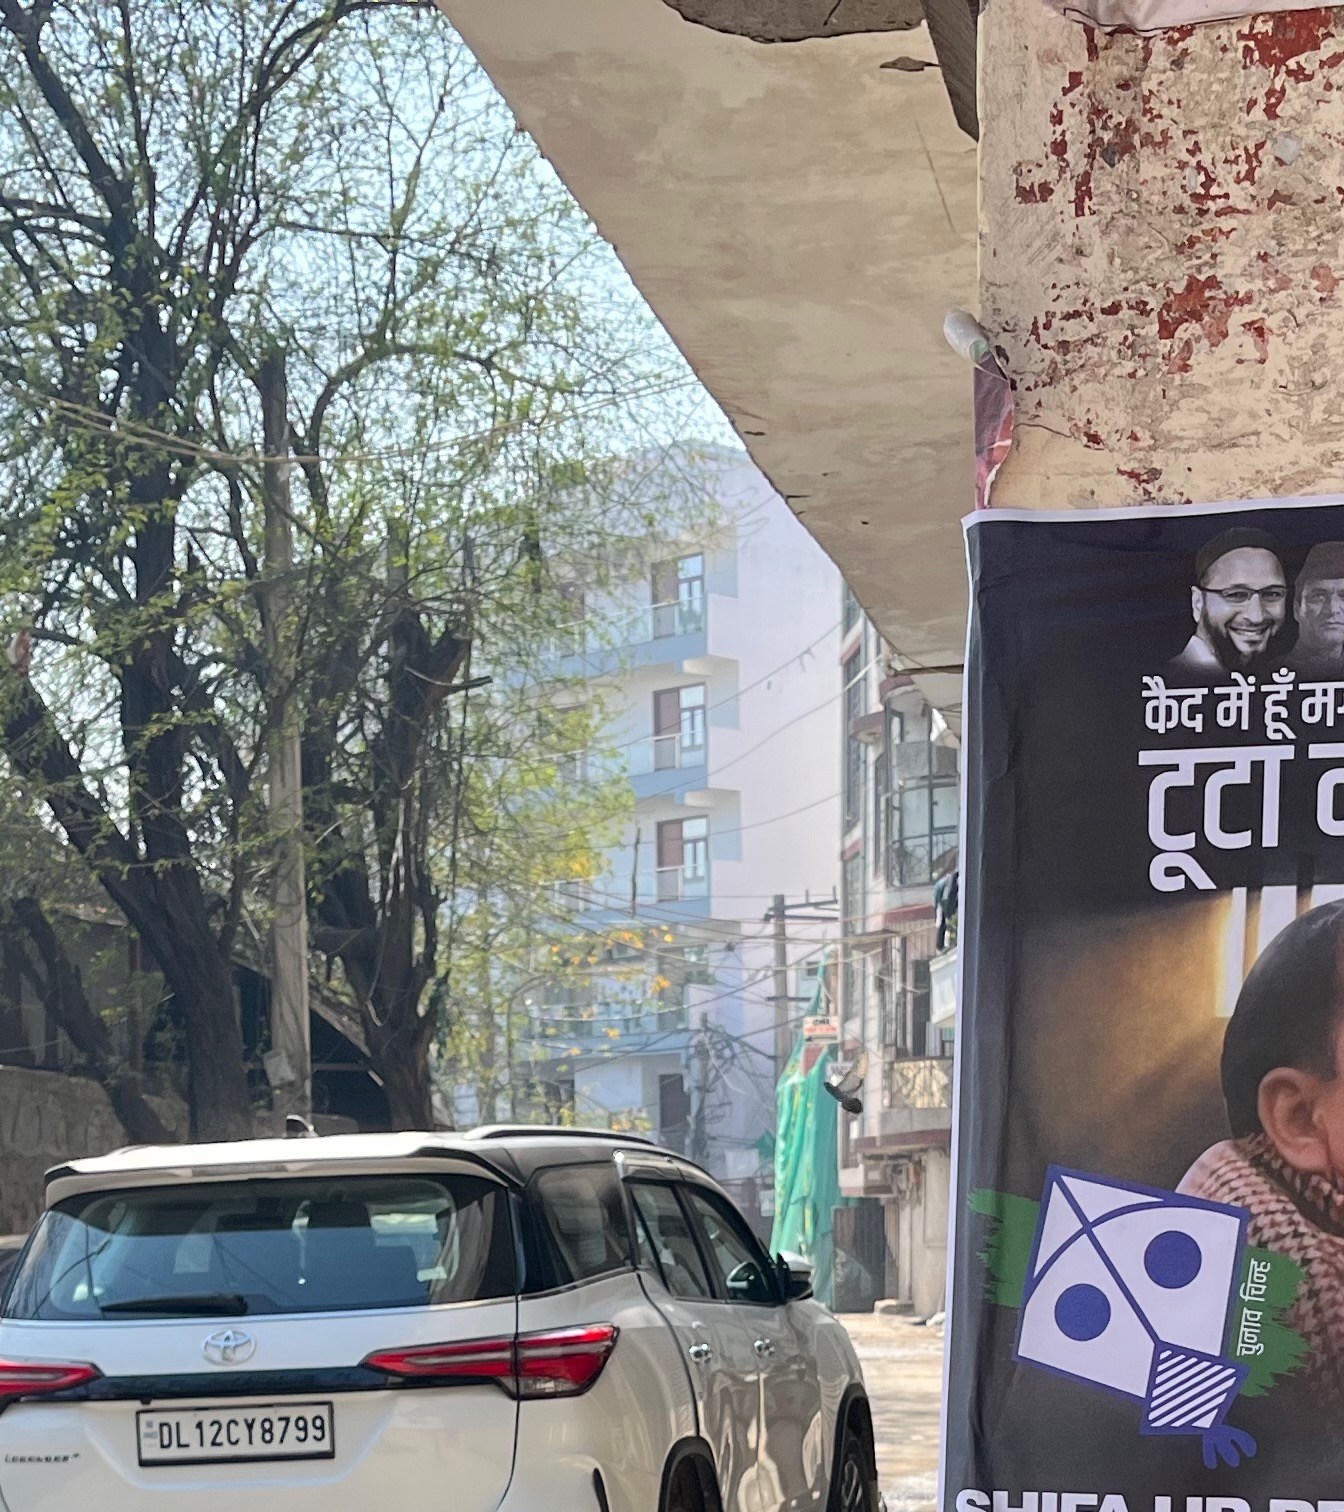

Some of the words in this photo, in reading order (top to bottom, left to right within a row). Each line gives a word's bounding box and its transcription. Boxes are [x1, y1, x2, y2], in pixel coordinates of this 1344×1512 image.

[1141, 675, 1209, 734] कैद
[1213, 671, 1256, 731] में
[1260, 667, 1297, 740] हूँ
[1138, 744, 1295, 893] टूटा
[1239, 1257, 1271, 1302] चिन्ह
[1236, 1306, 1265, 1357] चुनाव
[158, 1414, 326, 1449] DL12CY8799
